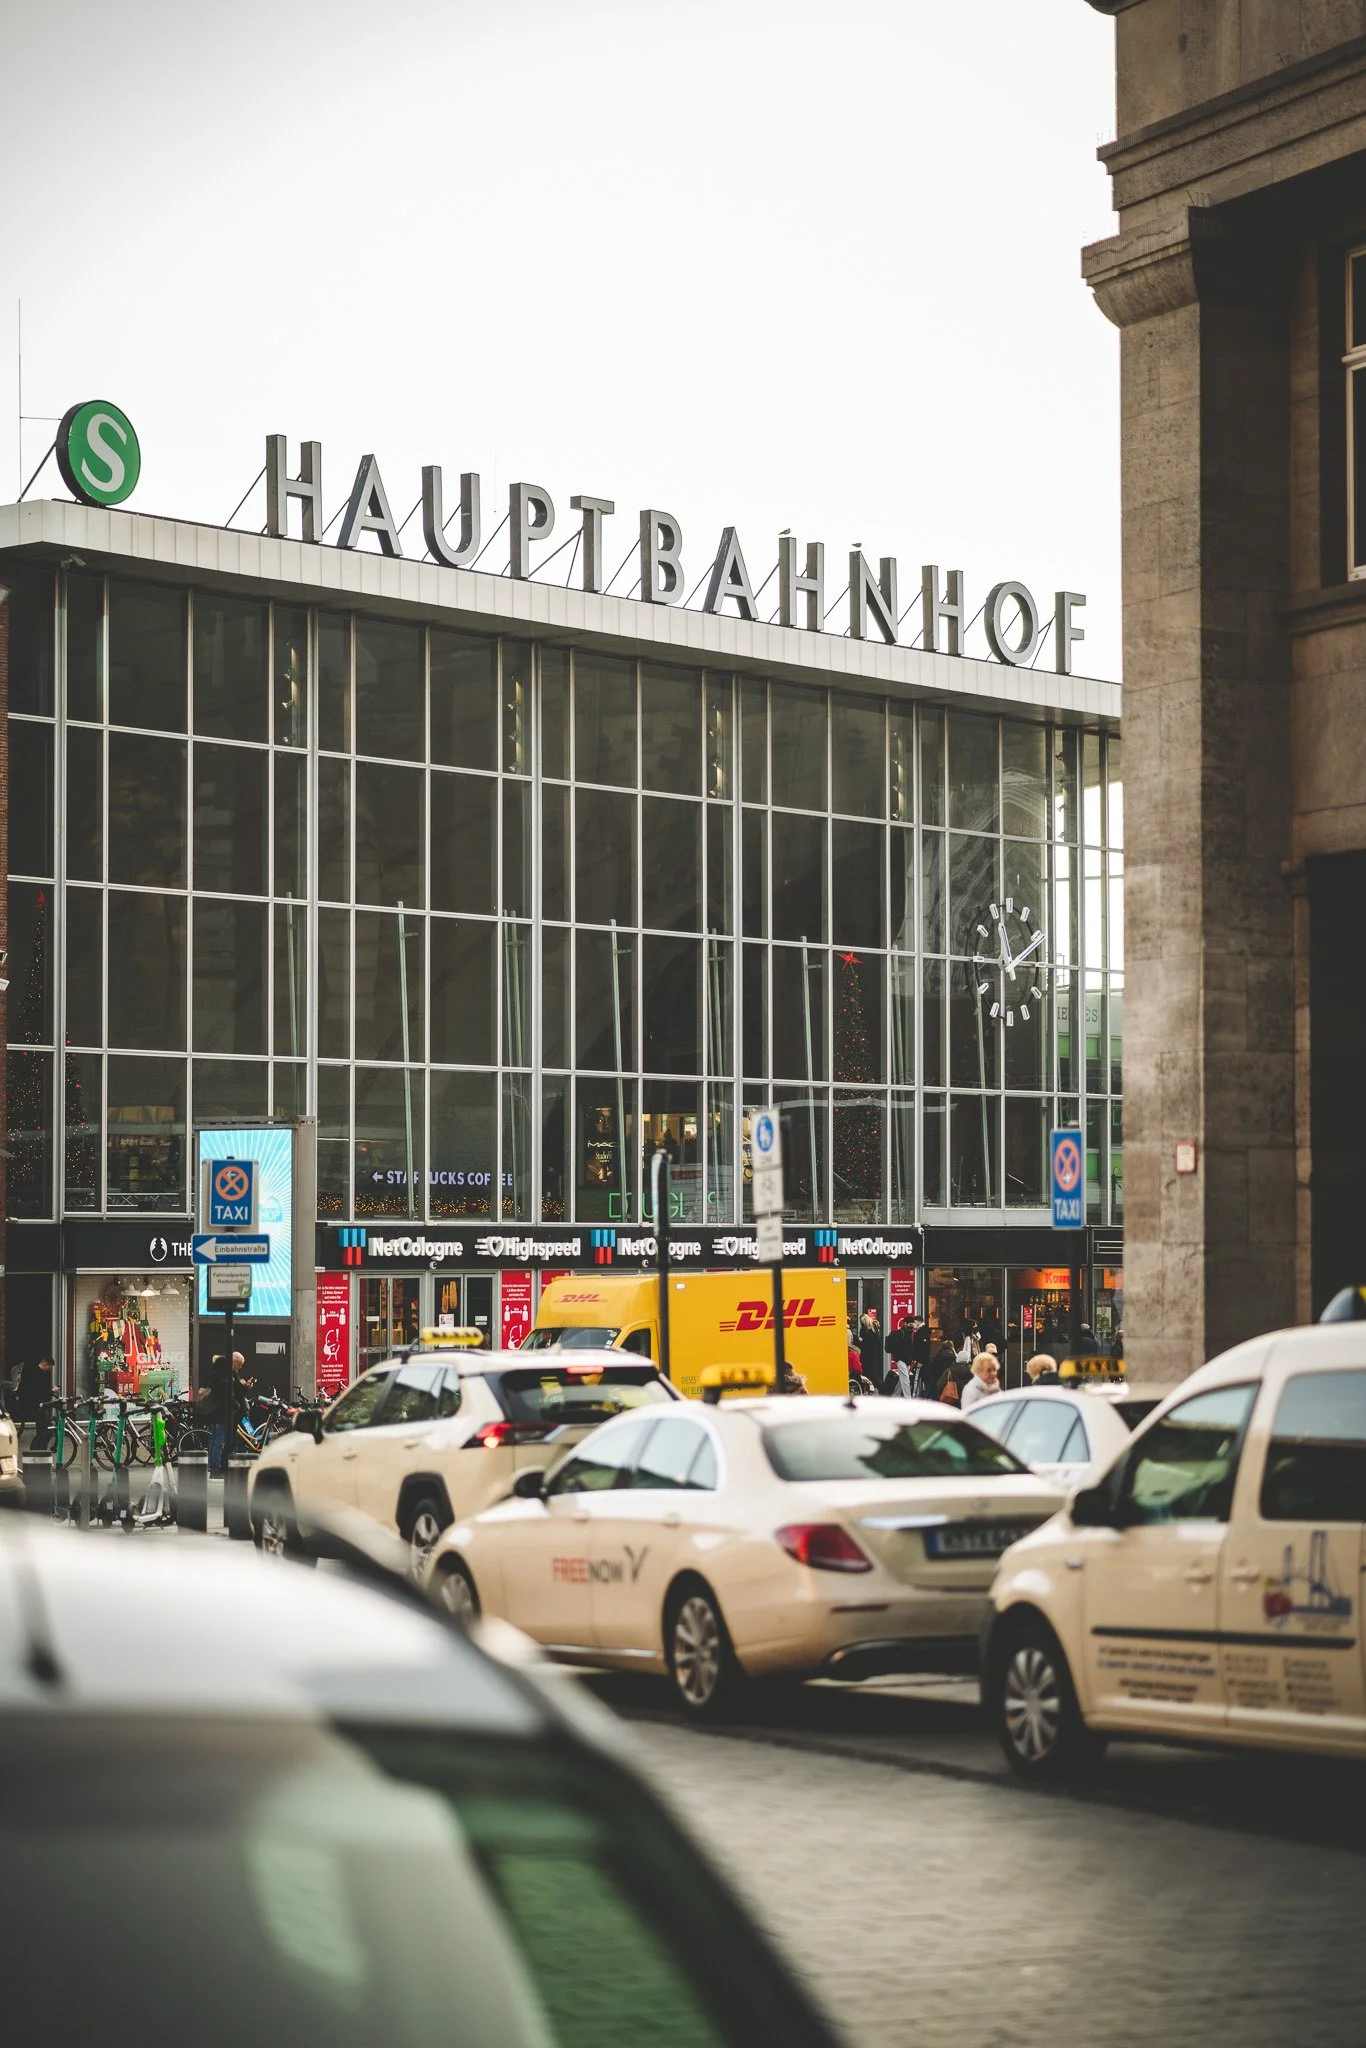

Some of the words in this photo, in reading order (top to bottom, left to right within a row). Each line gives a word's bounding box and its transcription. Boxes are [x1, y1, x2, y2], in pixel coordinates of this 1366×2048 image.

[81, 413, 128, 493] S
[266, 434, 1087, 675] HAUPTBAHNHOF
[467, 1172, 513, 1186] COFEE
[214, 1205, 248, 1220] TAXI
[1054, 1198, 1080, 1220] TAXI
[214, 1245, 266, 1254] Einbahnstraße
[368, 1237, 464, 1261] NetCologne
[504, 1237, 581, 1261] Highspeed
[616, 1237, 702, 1261] NetCogne
[738, 1237, 806, 1260] Higeed
[837, 1237, 913, 1259] NetCologne
[1044, 1271, 1070, 1284] Kam
[561, 1293, 601, 1303] DHL
[736, 1298, 821, 1331] DHL
